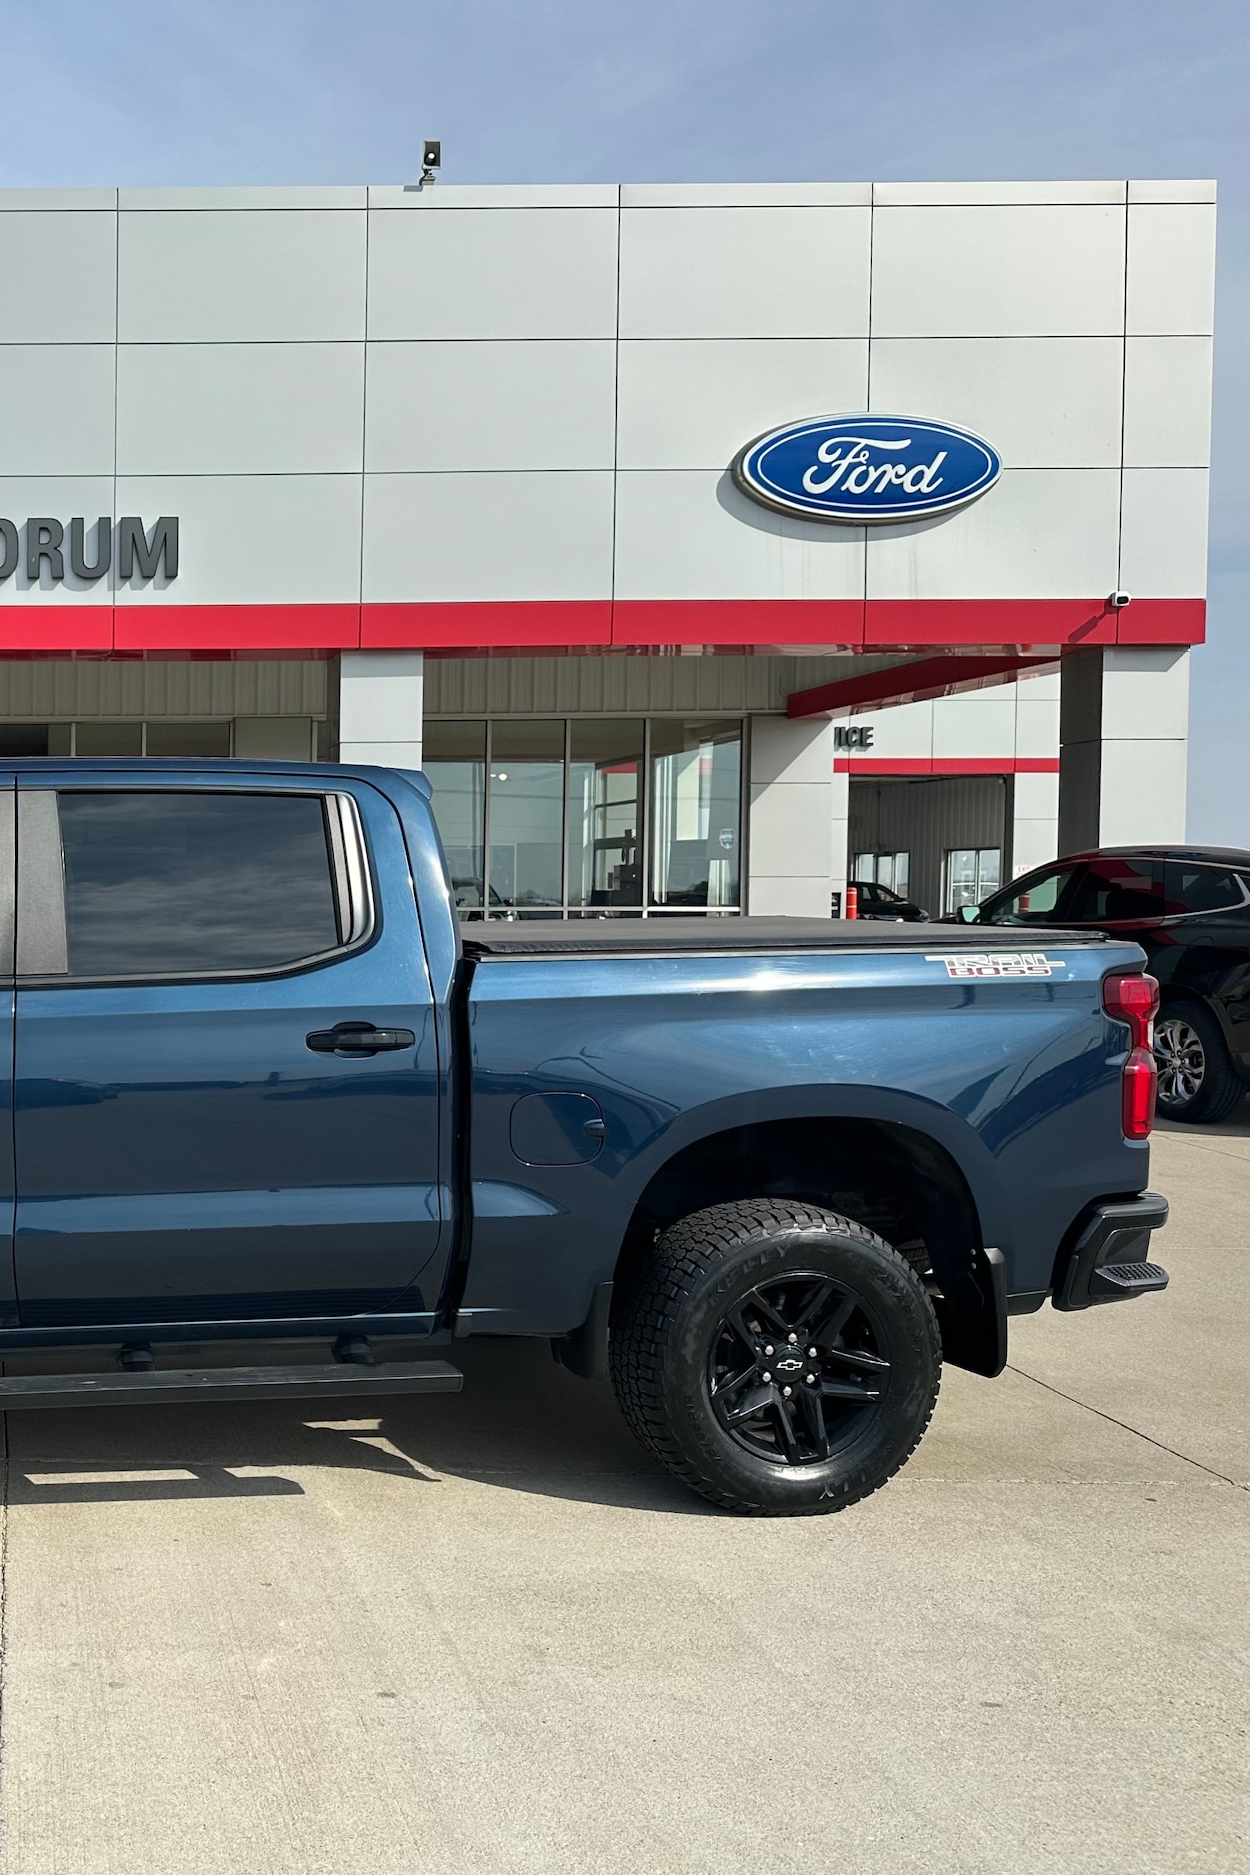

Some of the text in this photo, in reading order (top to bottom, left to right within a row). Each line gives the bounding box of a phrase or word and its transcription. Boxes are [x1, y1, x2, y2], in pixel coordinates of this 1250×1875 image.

[802, 436, 948, 494] Ford
[925, 953, 1066, 968] TRAIL
[949, 965, 1052, 978] BOSS
[705, 1243, 789, 1306] KELLY
